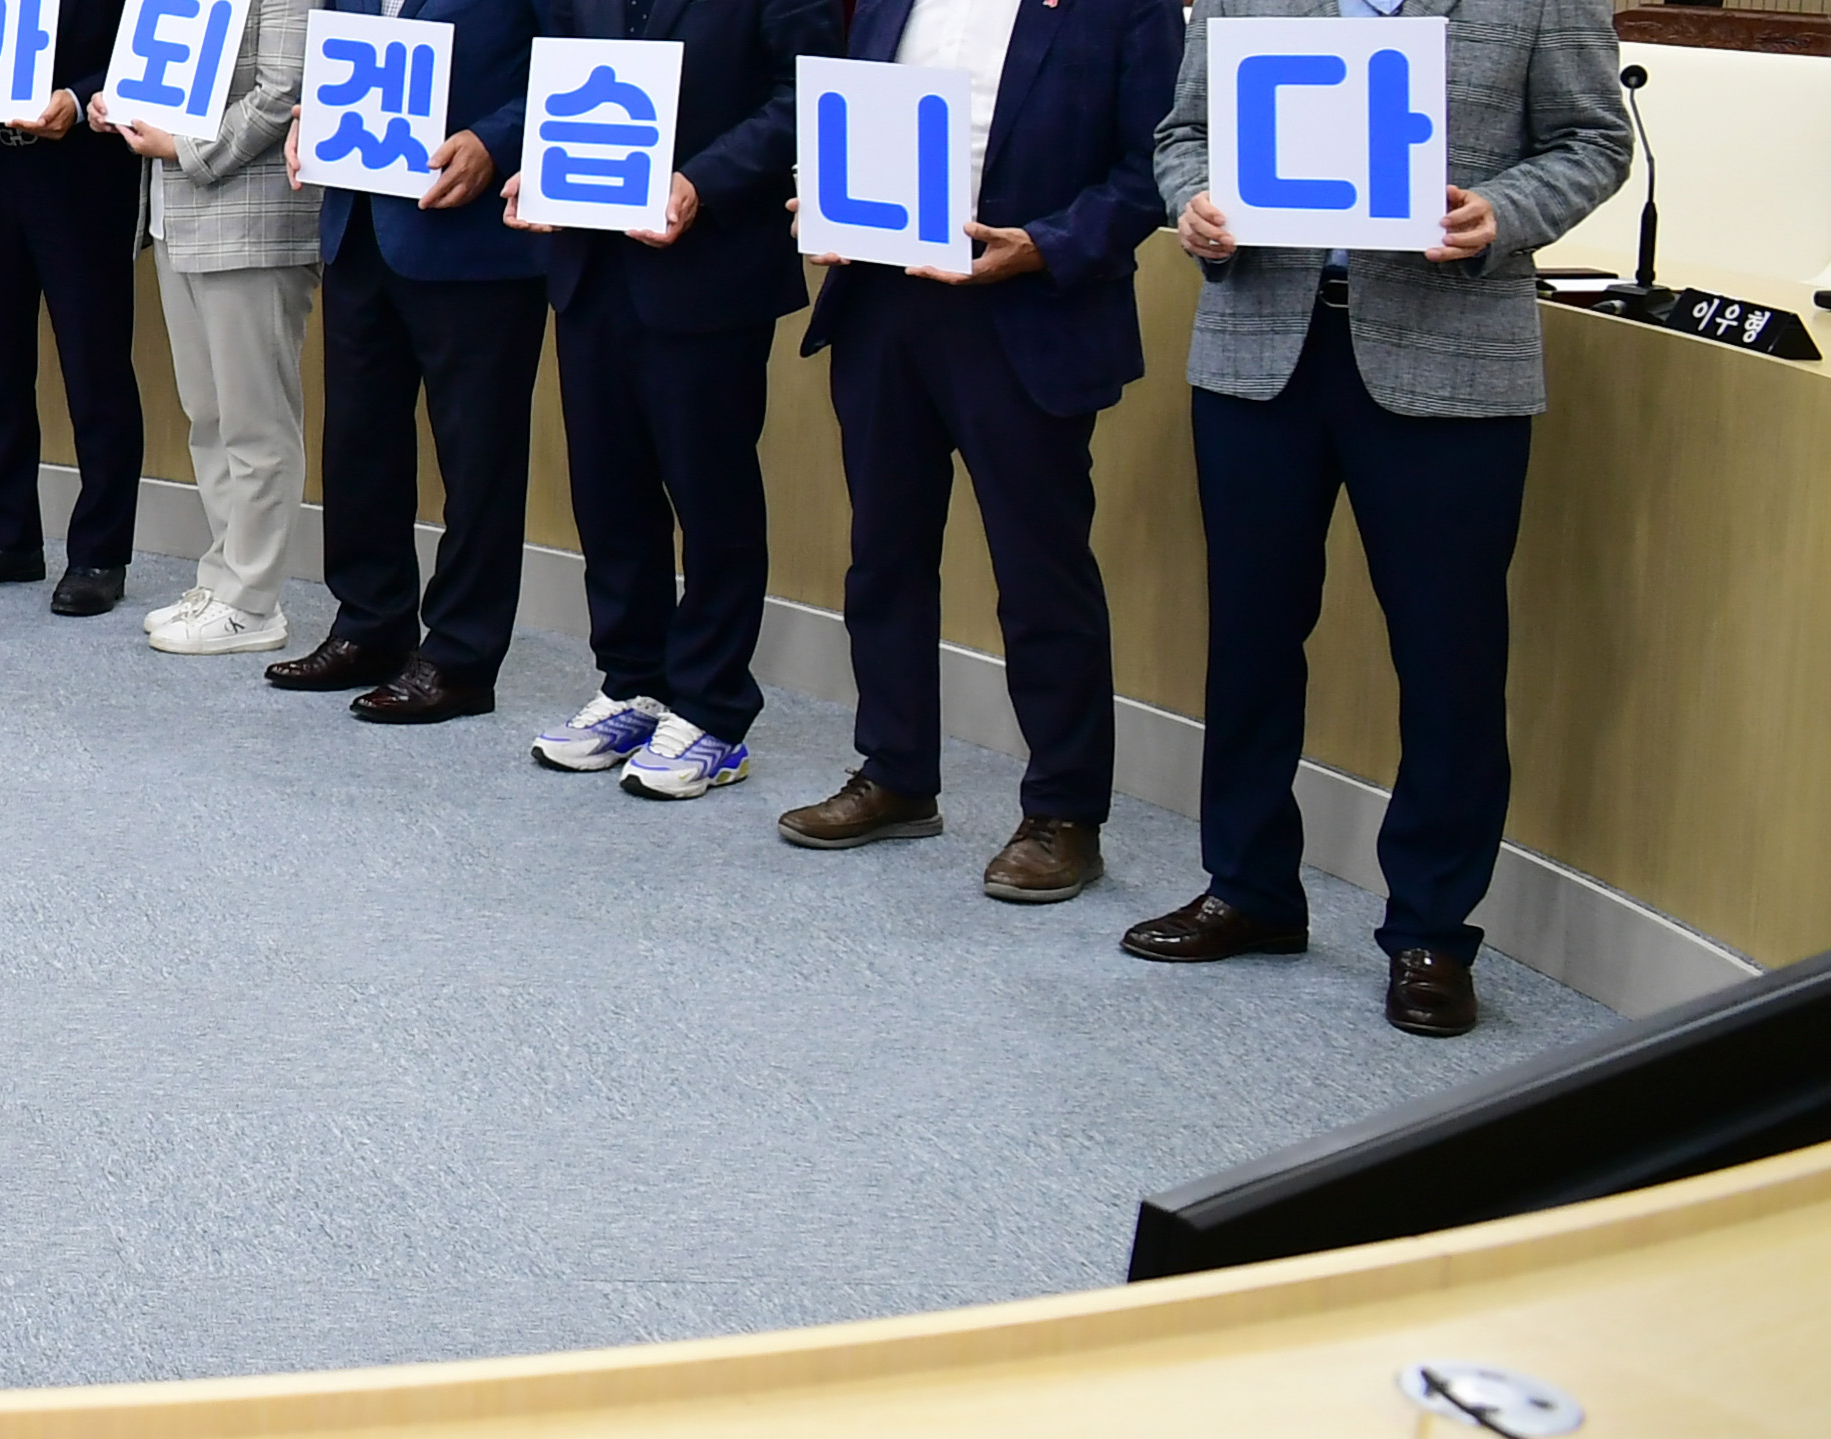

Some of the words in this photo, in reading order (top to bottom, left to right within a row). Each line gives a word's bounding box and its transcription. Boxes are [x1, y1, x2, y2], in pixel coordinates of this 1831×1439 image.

[314, 37, 437, 176] 겠
[538, 63, 661, 208] 습
[816, 90, 952, 246] 니
[1235, 47, 1435, 221] 다
[1692, 297, 1772, 343] 이우형
